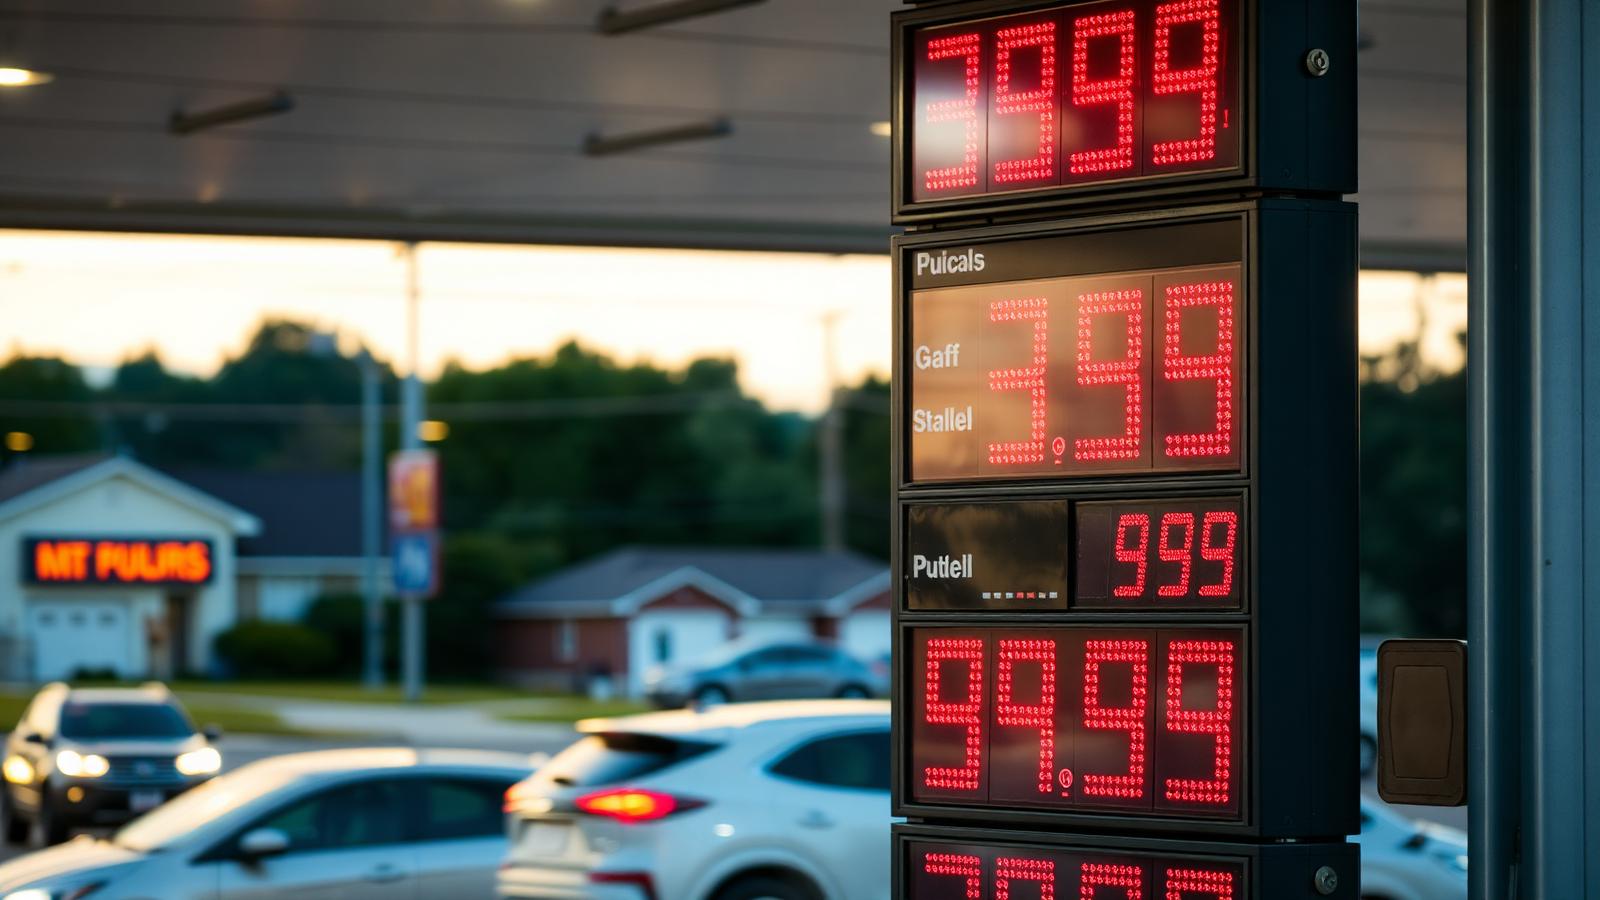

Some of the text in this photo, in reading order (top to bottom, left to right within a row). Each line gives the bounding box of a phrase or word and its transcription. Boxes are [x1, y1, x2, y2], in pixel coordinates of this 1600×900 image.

[917, 248, 985, 276] Puicals
[915, 343, 961, 370] Gaff
[913, 405, 973, 433] Stallel
[1113, 511, 1238, 597] 999
